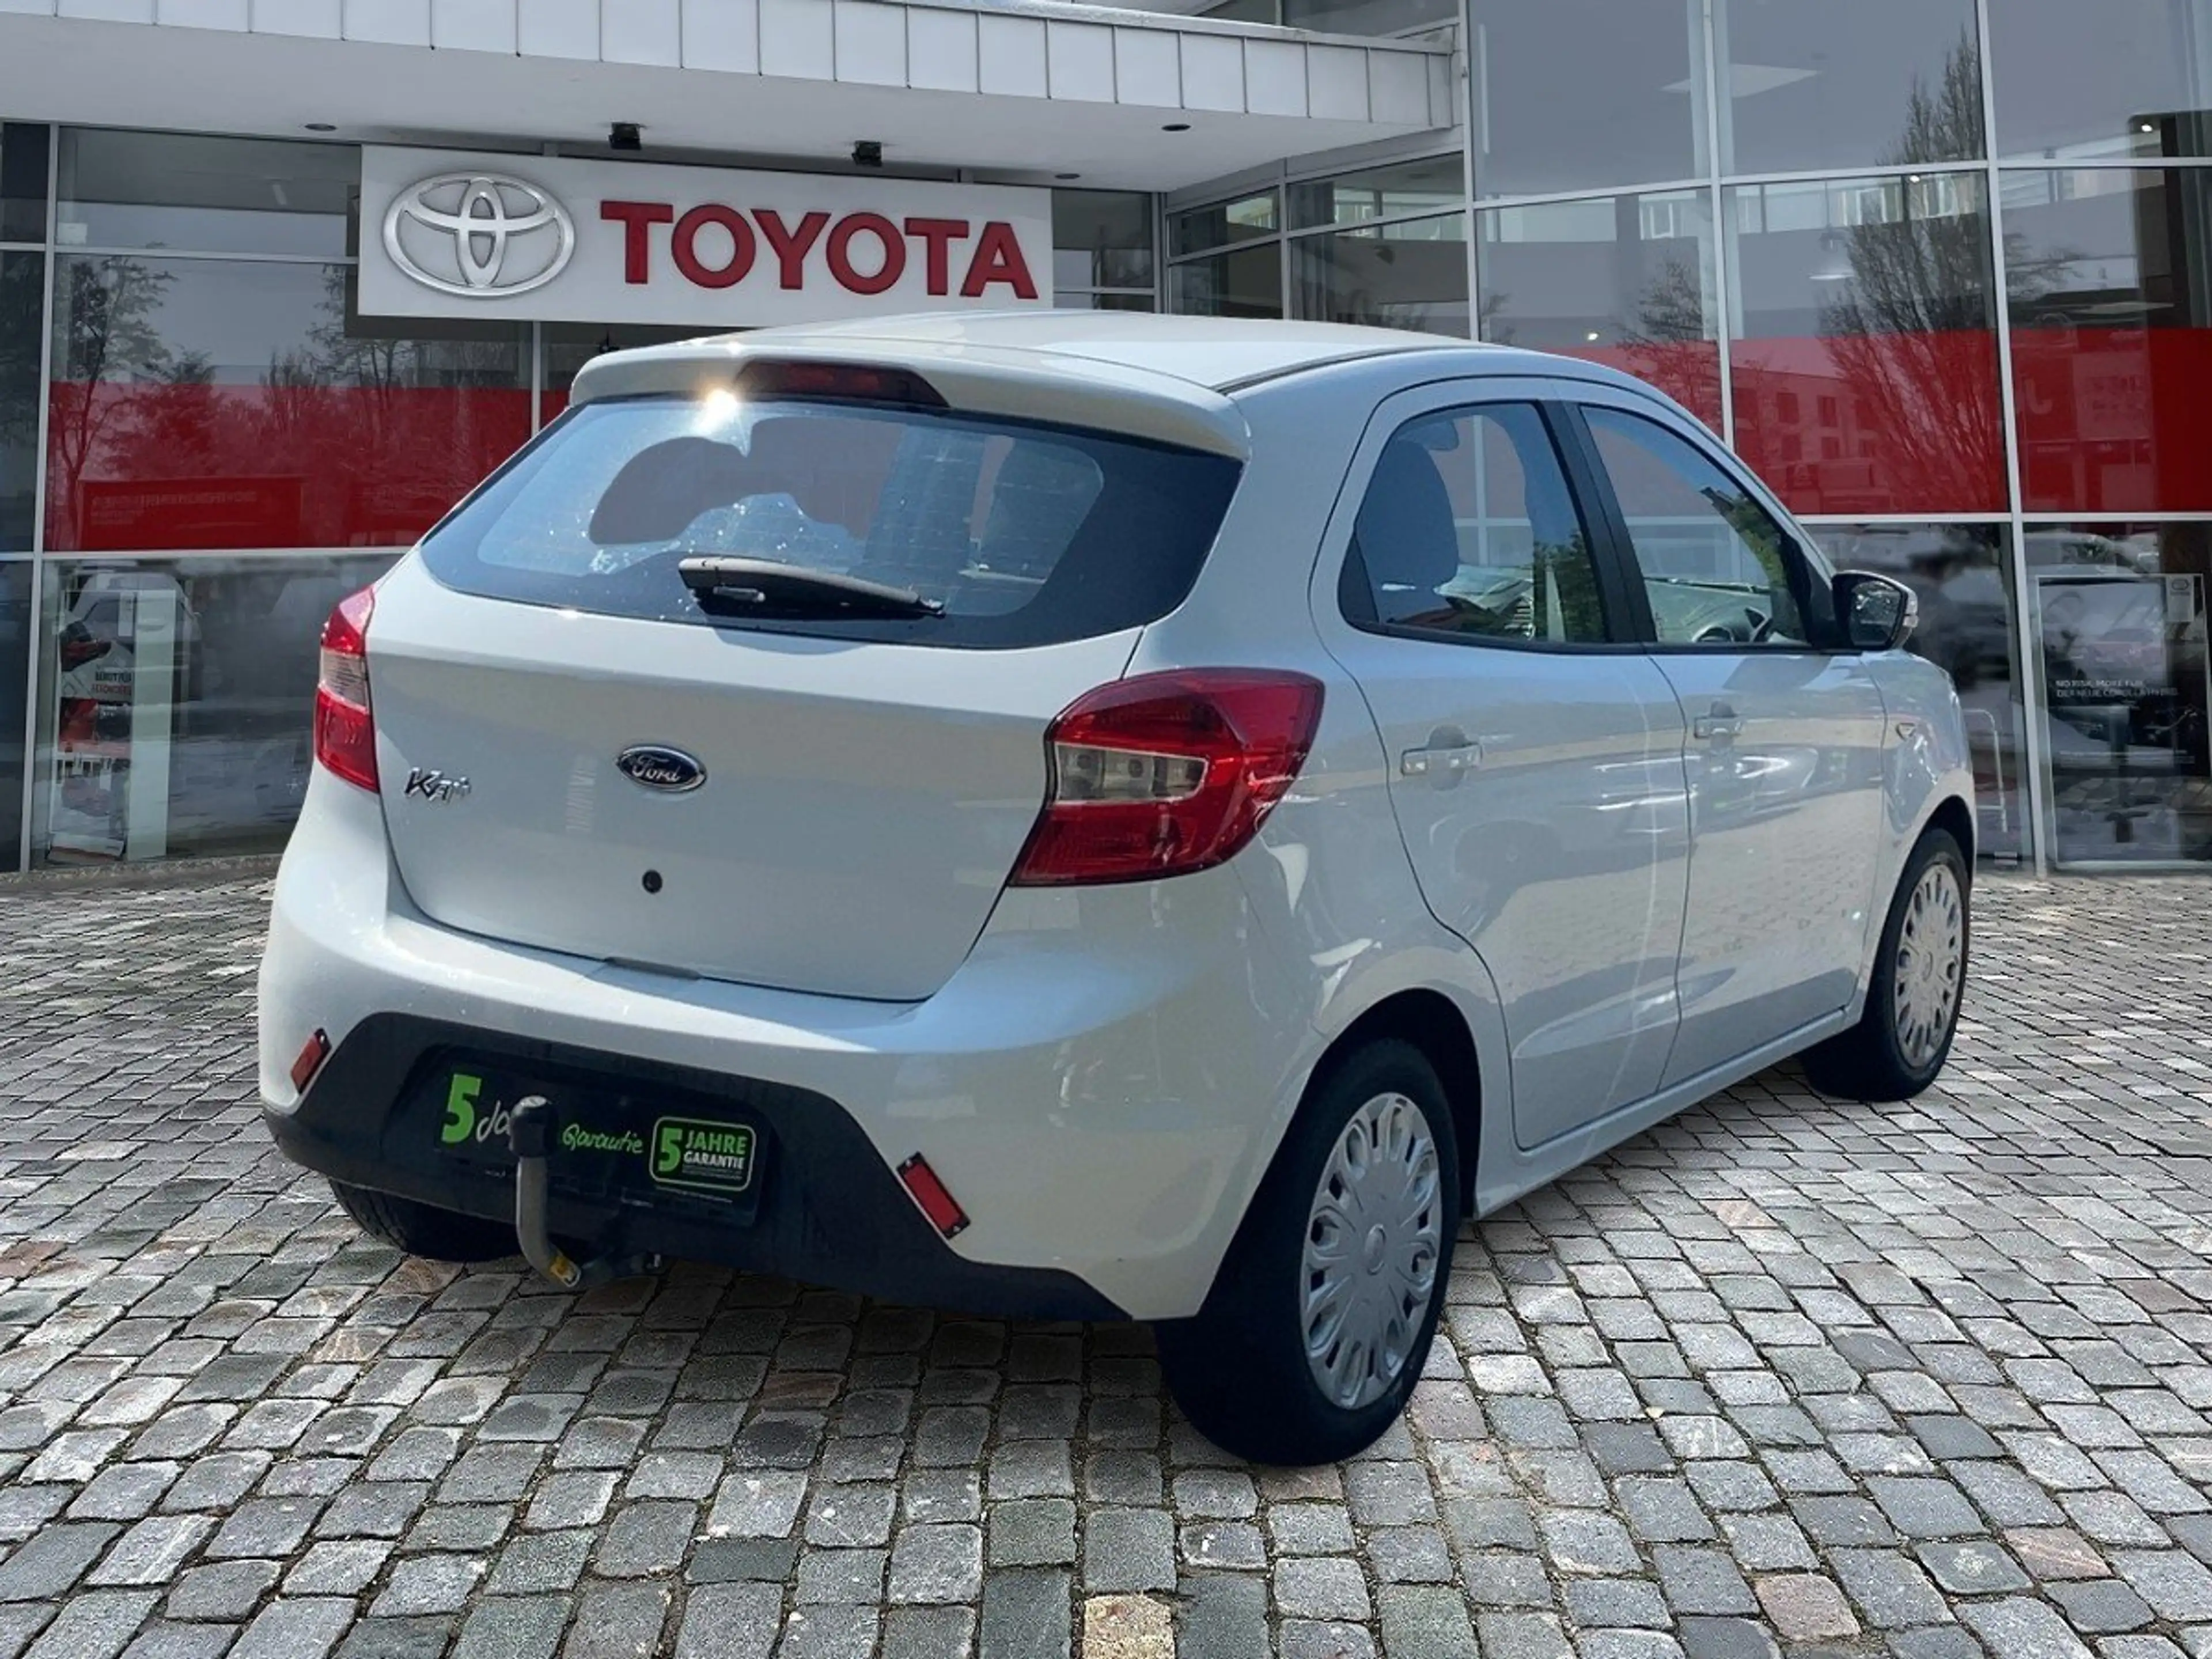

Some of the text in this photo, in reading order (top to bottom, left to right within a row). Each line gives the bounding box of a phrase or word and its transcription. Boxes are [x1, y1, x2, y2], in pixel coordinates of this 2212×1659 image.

[600, 199, 1039, 300] TOYOTA
[631, 753, 681, 782] Ford
[441, 1073, 482, 1143] 5
[562, 1123, 643, 1154] Garantie
[658, 1127, 683, 1172] 5
[685, 1130, 748, 1155] JAHRE
[684, 1151, 745, 1169] GARANTIE
